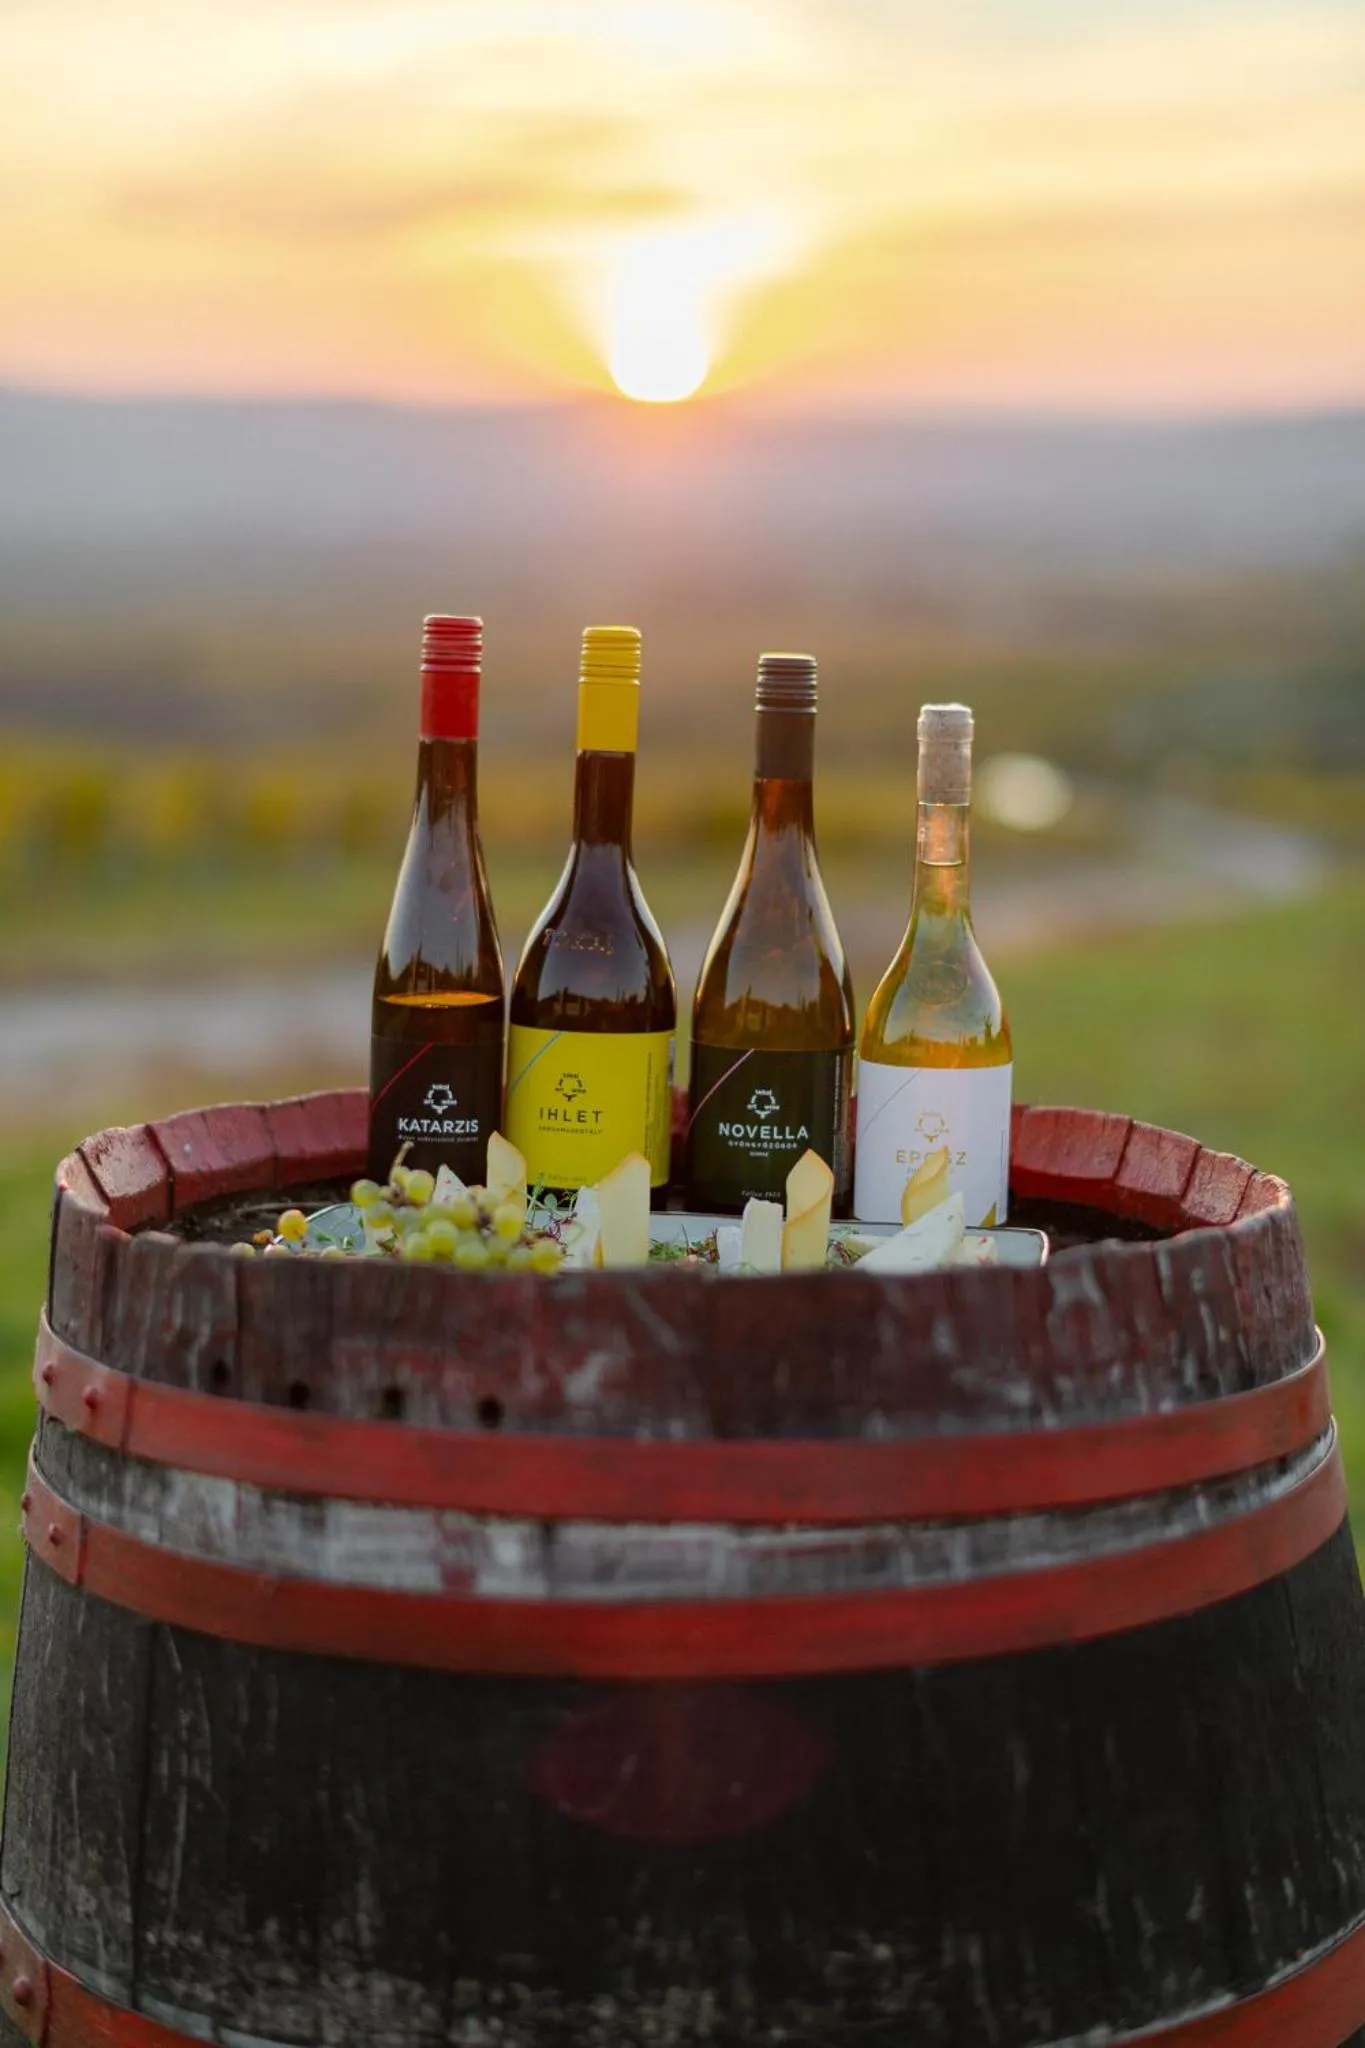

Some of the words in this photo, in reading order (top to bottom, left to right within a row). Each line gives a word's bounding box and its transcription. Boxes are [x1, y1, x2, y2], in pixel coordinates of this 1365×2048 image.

[539, 1107, 603, 1124] IHLET
[398, 1117, 479, 1133] KATARZIS
[718, 1122, 809, 1140] NOVELLA
